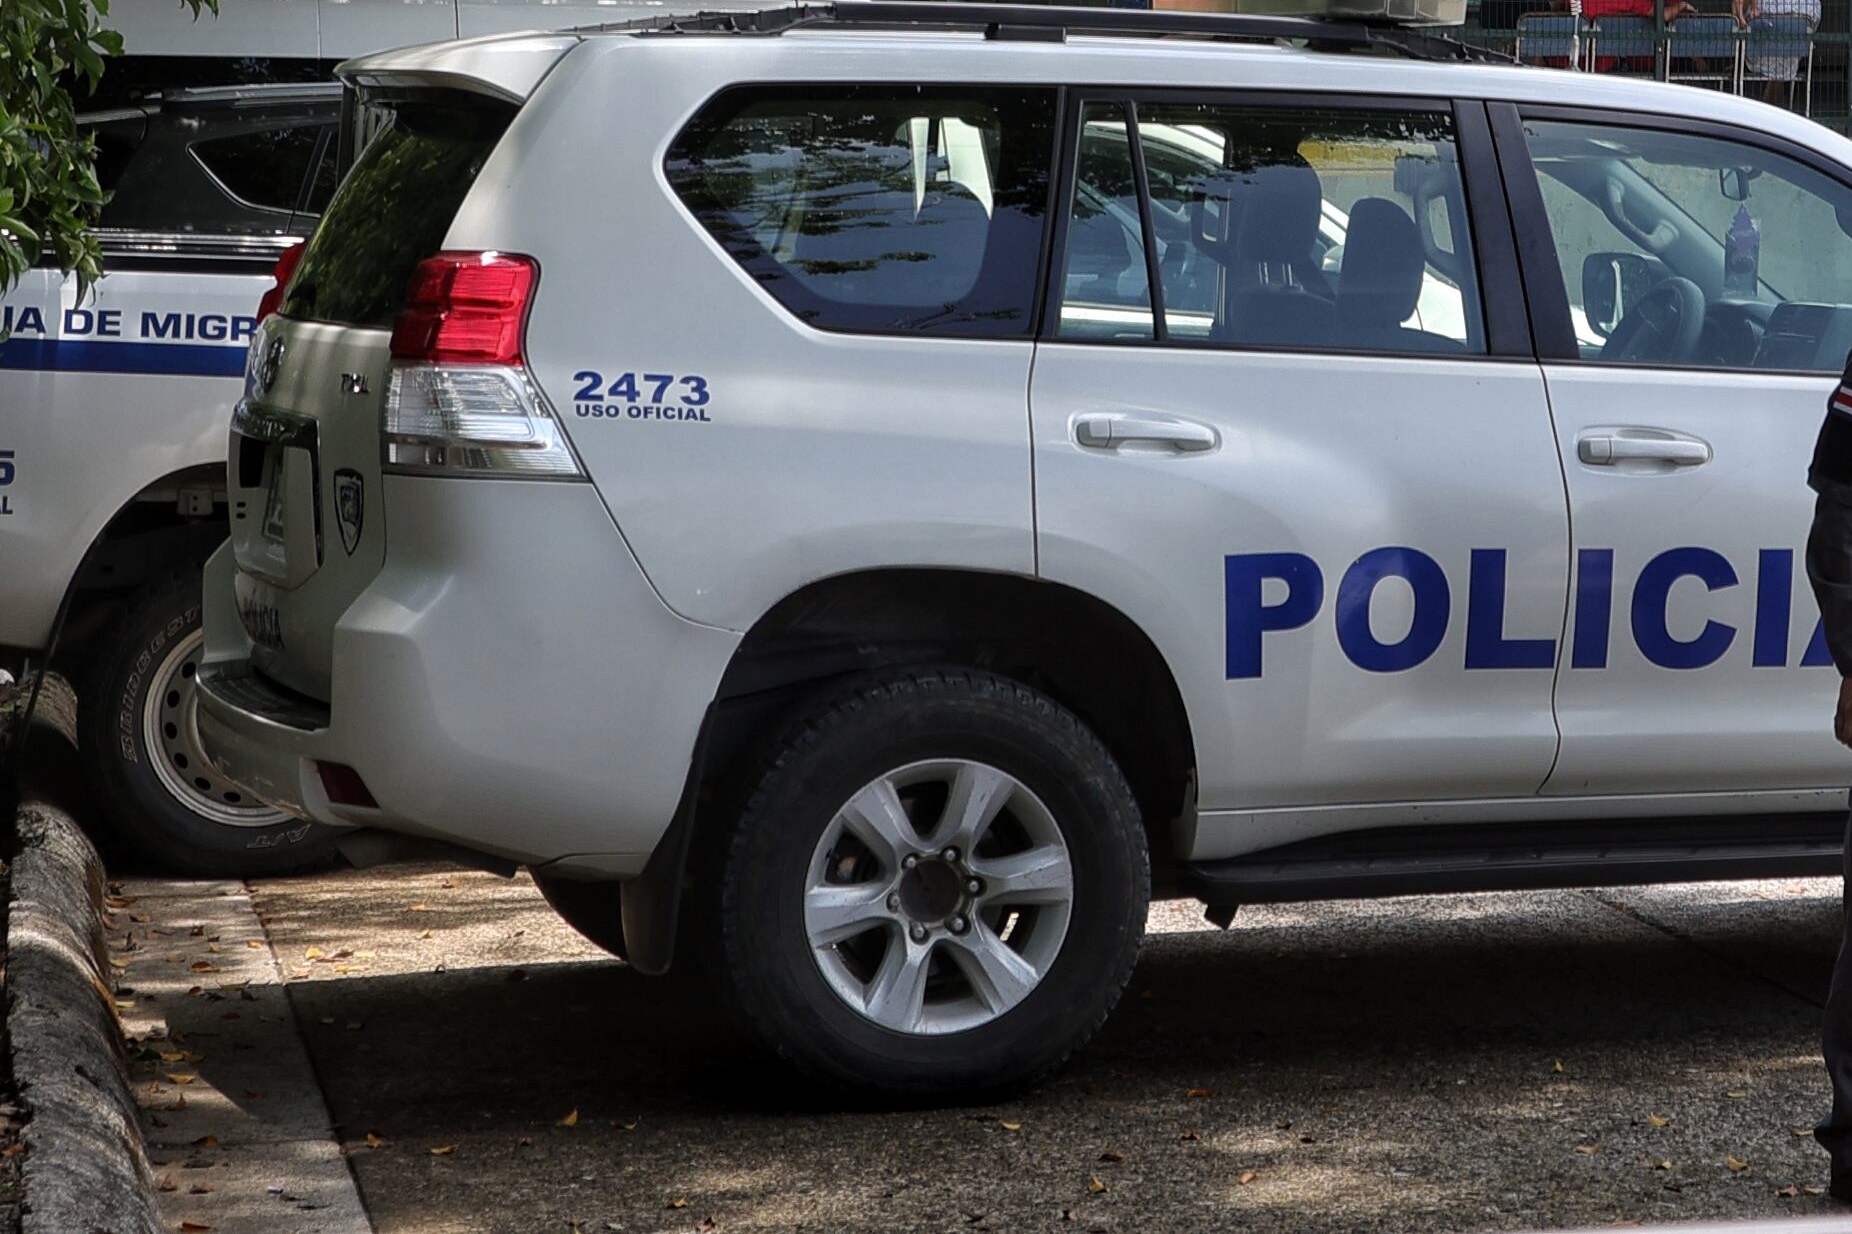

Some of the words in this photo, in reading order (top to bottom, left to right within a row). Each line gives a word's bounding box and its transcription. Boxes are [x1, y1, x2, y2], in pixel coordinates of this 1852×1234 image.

[63, 309, 122, 336] DE
[140, 312, 258, 341] MIGR
[573, 370, 710, 406] 2473
[576, 404, 620, 418] USO
[627, 405, 712, 422] OFICIAL
[1224, 545, 1837, 681] POLICI
